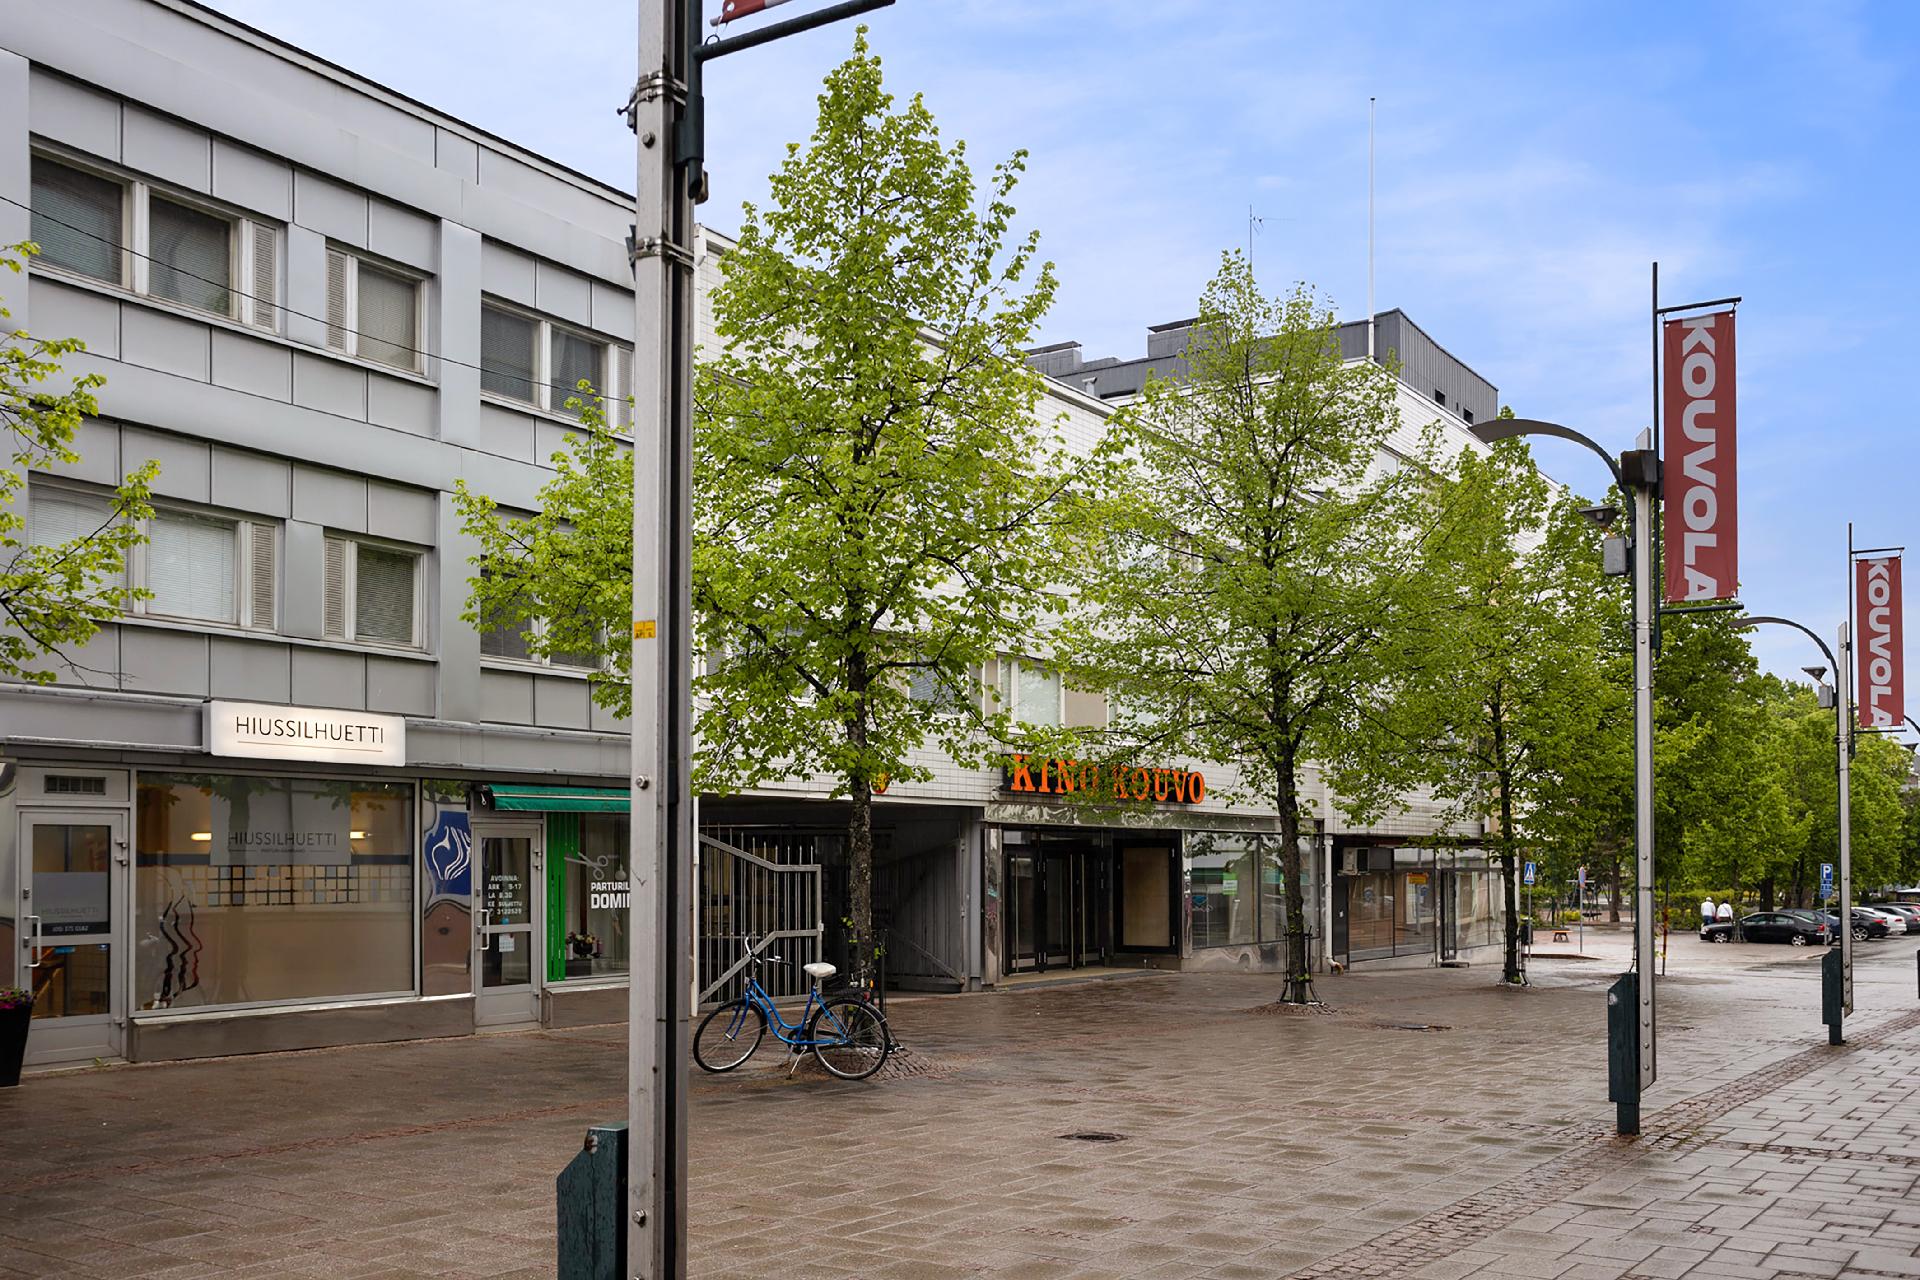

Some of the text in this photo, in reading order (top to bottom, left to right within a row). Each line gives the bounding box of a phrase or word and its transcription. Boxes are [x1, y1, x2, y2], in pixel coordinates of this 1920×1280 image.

[1682, 313, 1717, 601] KOUVOLA
[1868, 559, 1892, 728] KOUVOLA
[236, 716, 384, 743] HIUSSILHUETTI
[228, 831, 337, 846] HIUSSILHUETTI
